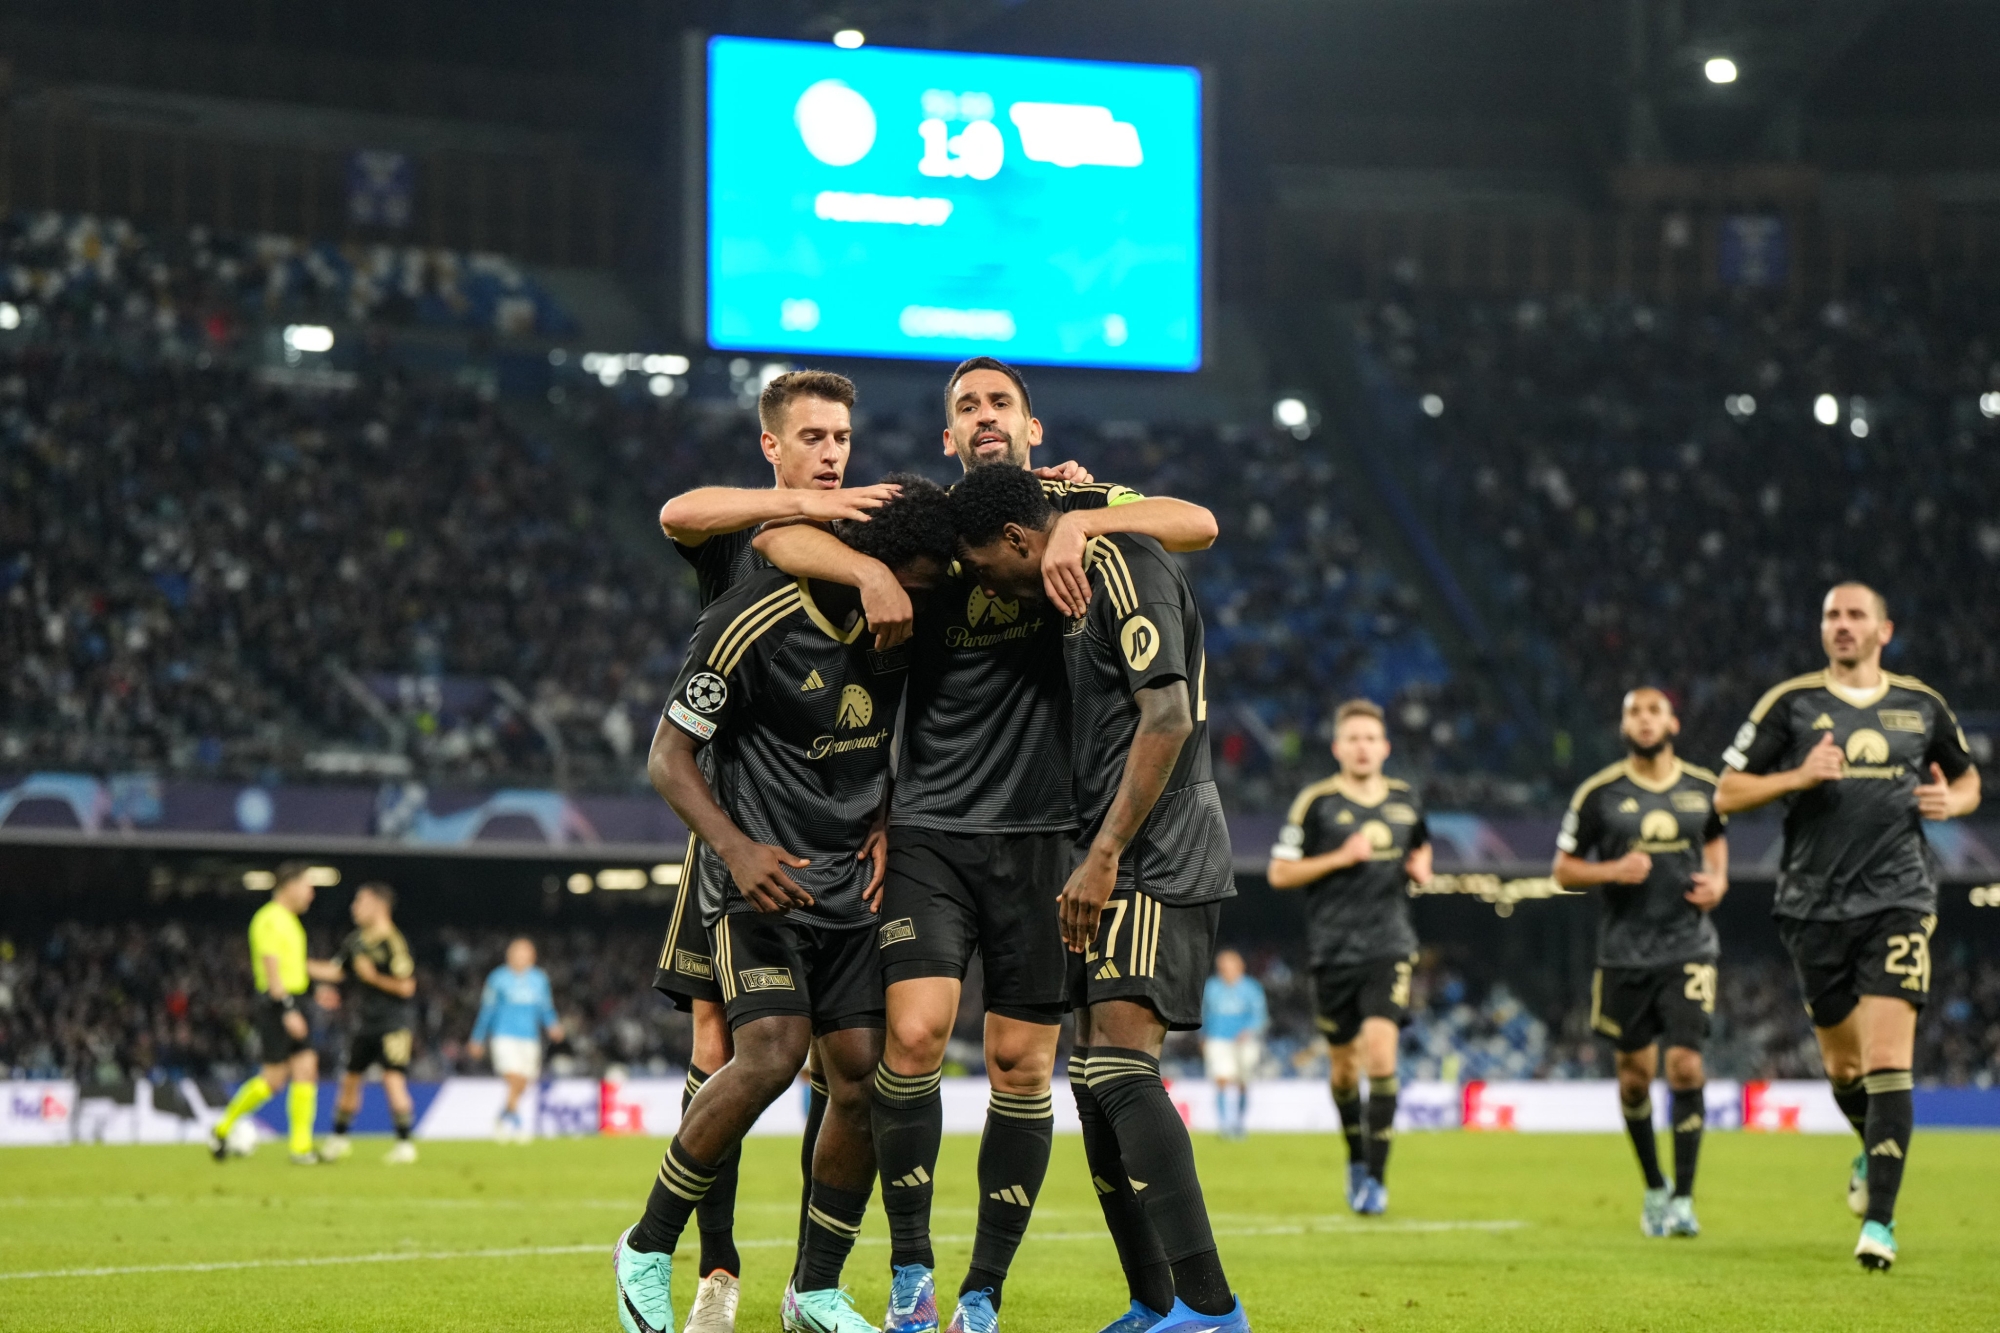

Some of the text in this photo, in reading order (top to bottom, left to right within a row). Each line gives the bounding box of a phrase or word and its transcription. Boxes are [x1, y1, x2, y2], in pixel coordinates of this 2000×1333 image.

[1130, 625, 1152, 663] JD
[671, 705, 714, 735] FOUNDATION
[807, 728, 888, 760] Paramount+
[1884, 932, 1928, 977] 23
